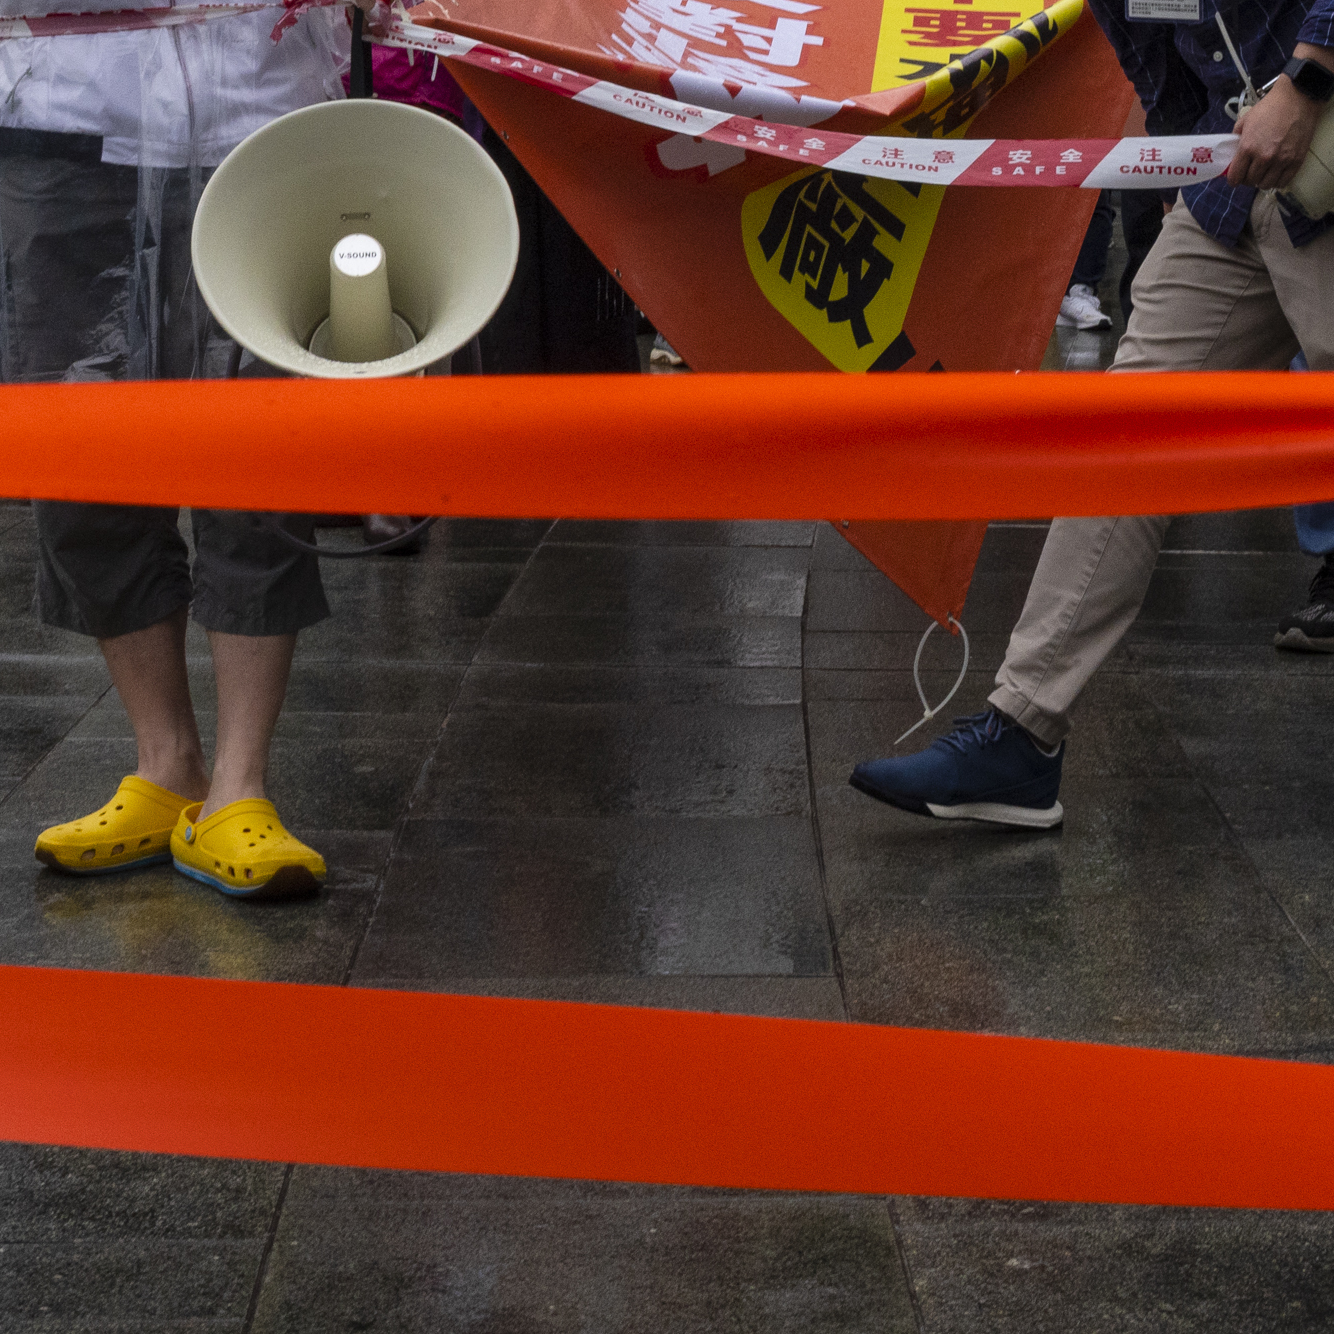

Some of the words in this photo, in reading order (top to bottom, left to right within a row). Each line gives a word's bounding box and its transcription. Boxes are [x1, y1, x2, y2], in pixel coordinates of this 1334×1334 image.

[613, 93, 687, 124] CAUTION
[753, 125, 826, 152] 安全
[881, 147, 956, 165] 注意
[1008, 149, 1083, 165] 安全
[1138, 146, 1215, 165] 注意
[861, 157, 940, 174] CAUTION
[991, 166, 1068, 177] SAFE
[1119, 164, 1198, 177] CAUTION
